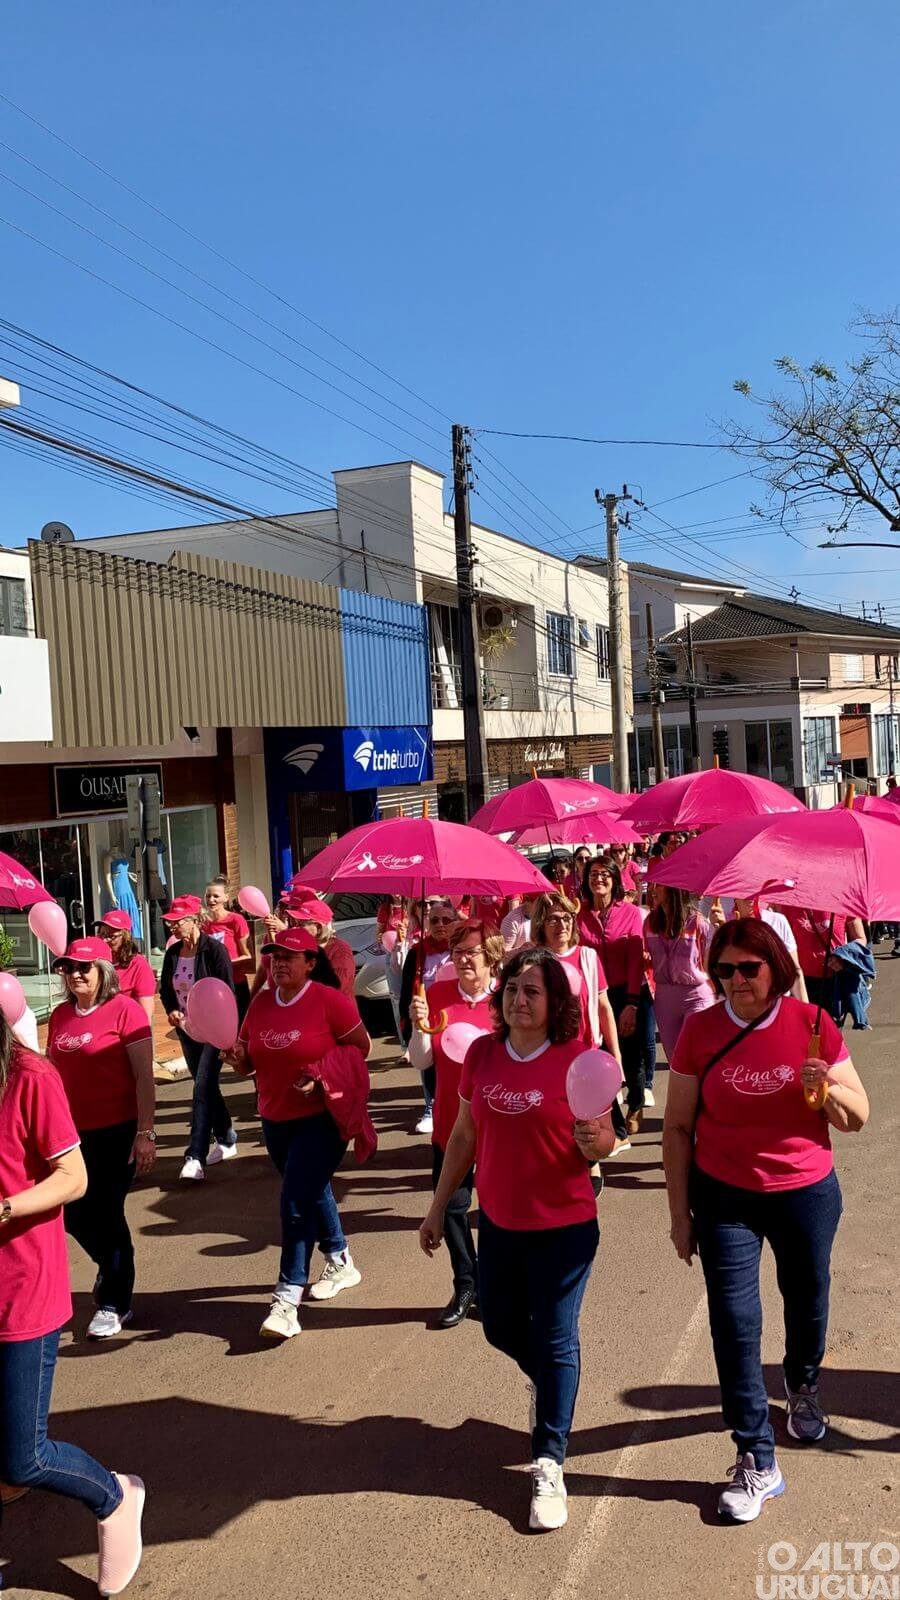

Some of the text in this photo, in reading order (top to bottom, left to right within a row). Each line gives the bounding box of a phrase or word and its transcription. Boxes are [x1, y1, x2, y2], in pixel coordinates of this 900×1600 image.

[372, 748, 419, 771] tchêturbo
[721, 1064, 771, 1087] Liga
[482, 1083, 522, 1105] Liga
